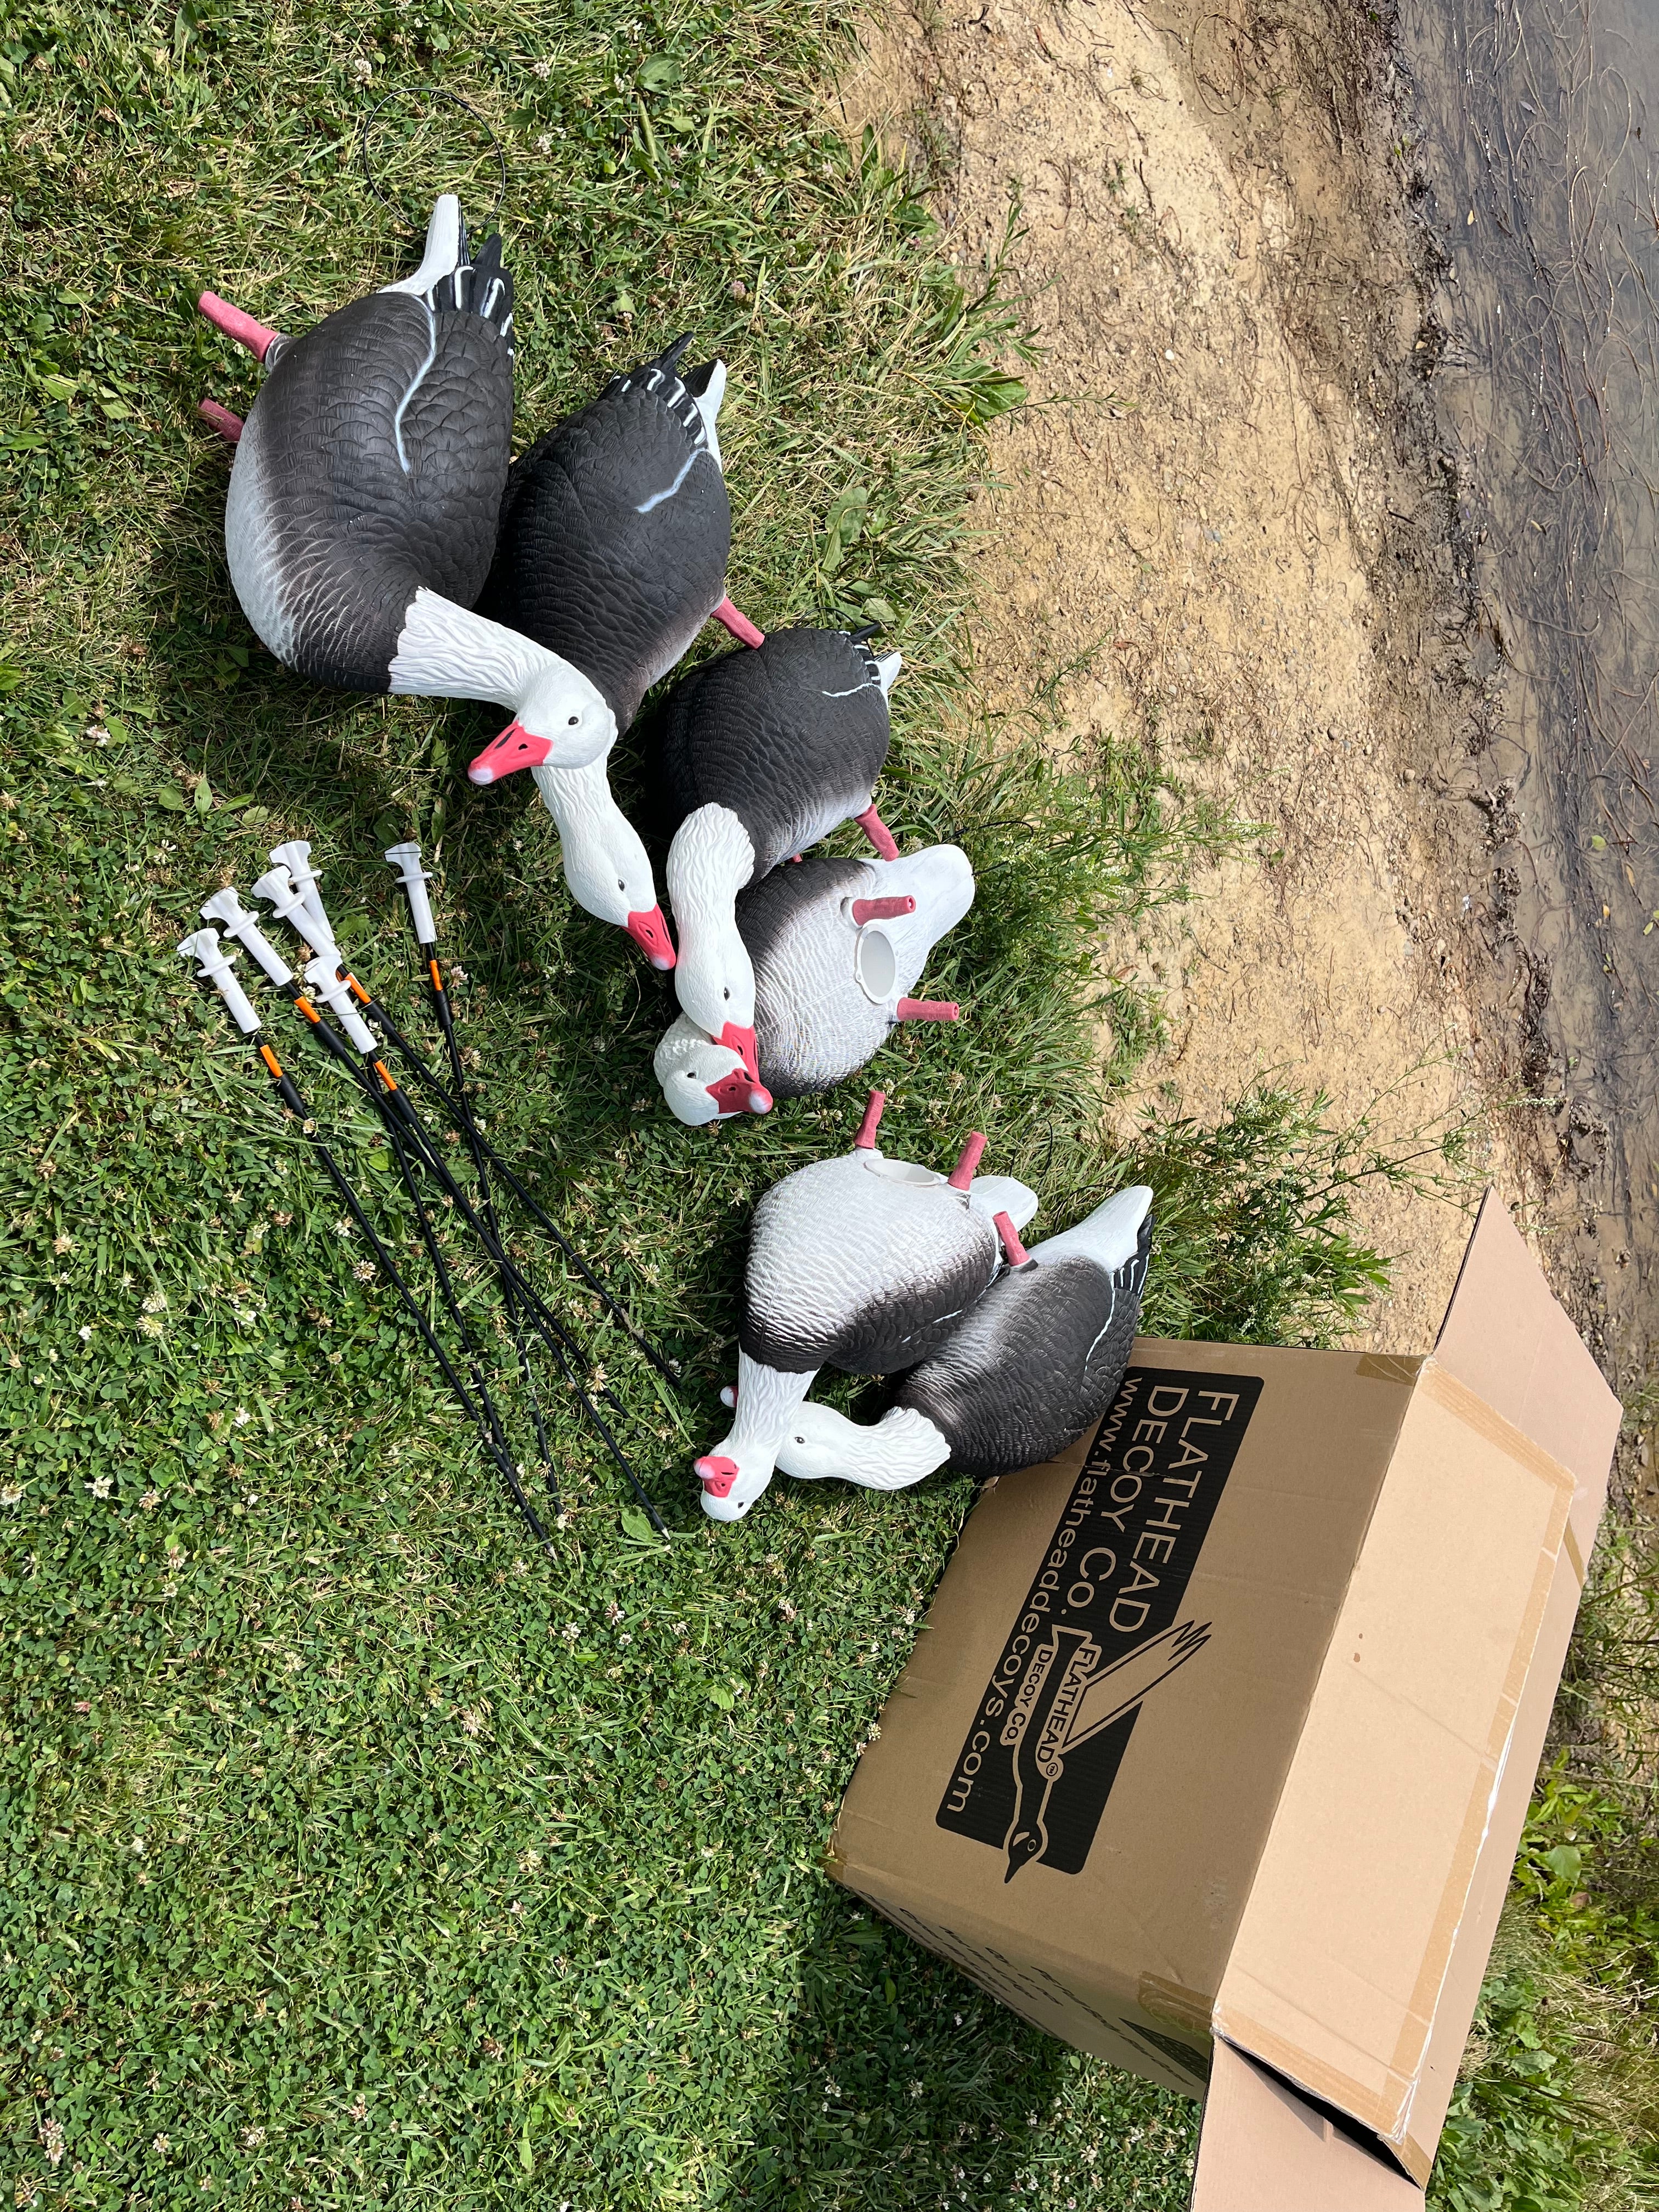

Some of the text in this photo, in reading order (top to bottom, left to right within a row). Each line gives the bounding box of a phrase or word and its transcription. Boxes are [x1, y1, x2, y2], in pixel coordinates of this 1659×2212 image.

[1101, 1385, 1189, 1533] DECOY
[1109, 1390, 1240, 1632] FLATHEAD
[946, 1377, 1143, 1812] www.flatheaddecoys.com
[1004, 1649, 1053, 1740] DECOY CO.
[1037, 1647, 1097, 1763] FLATHEAD
